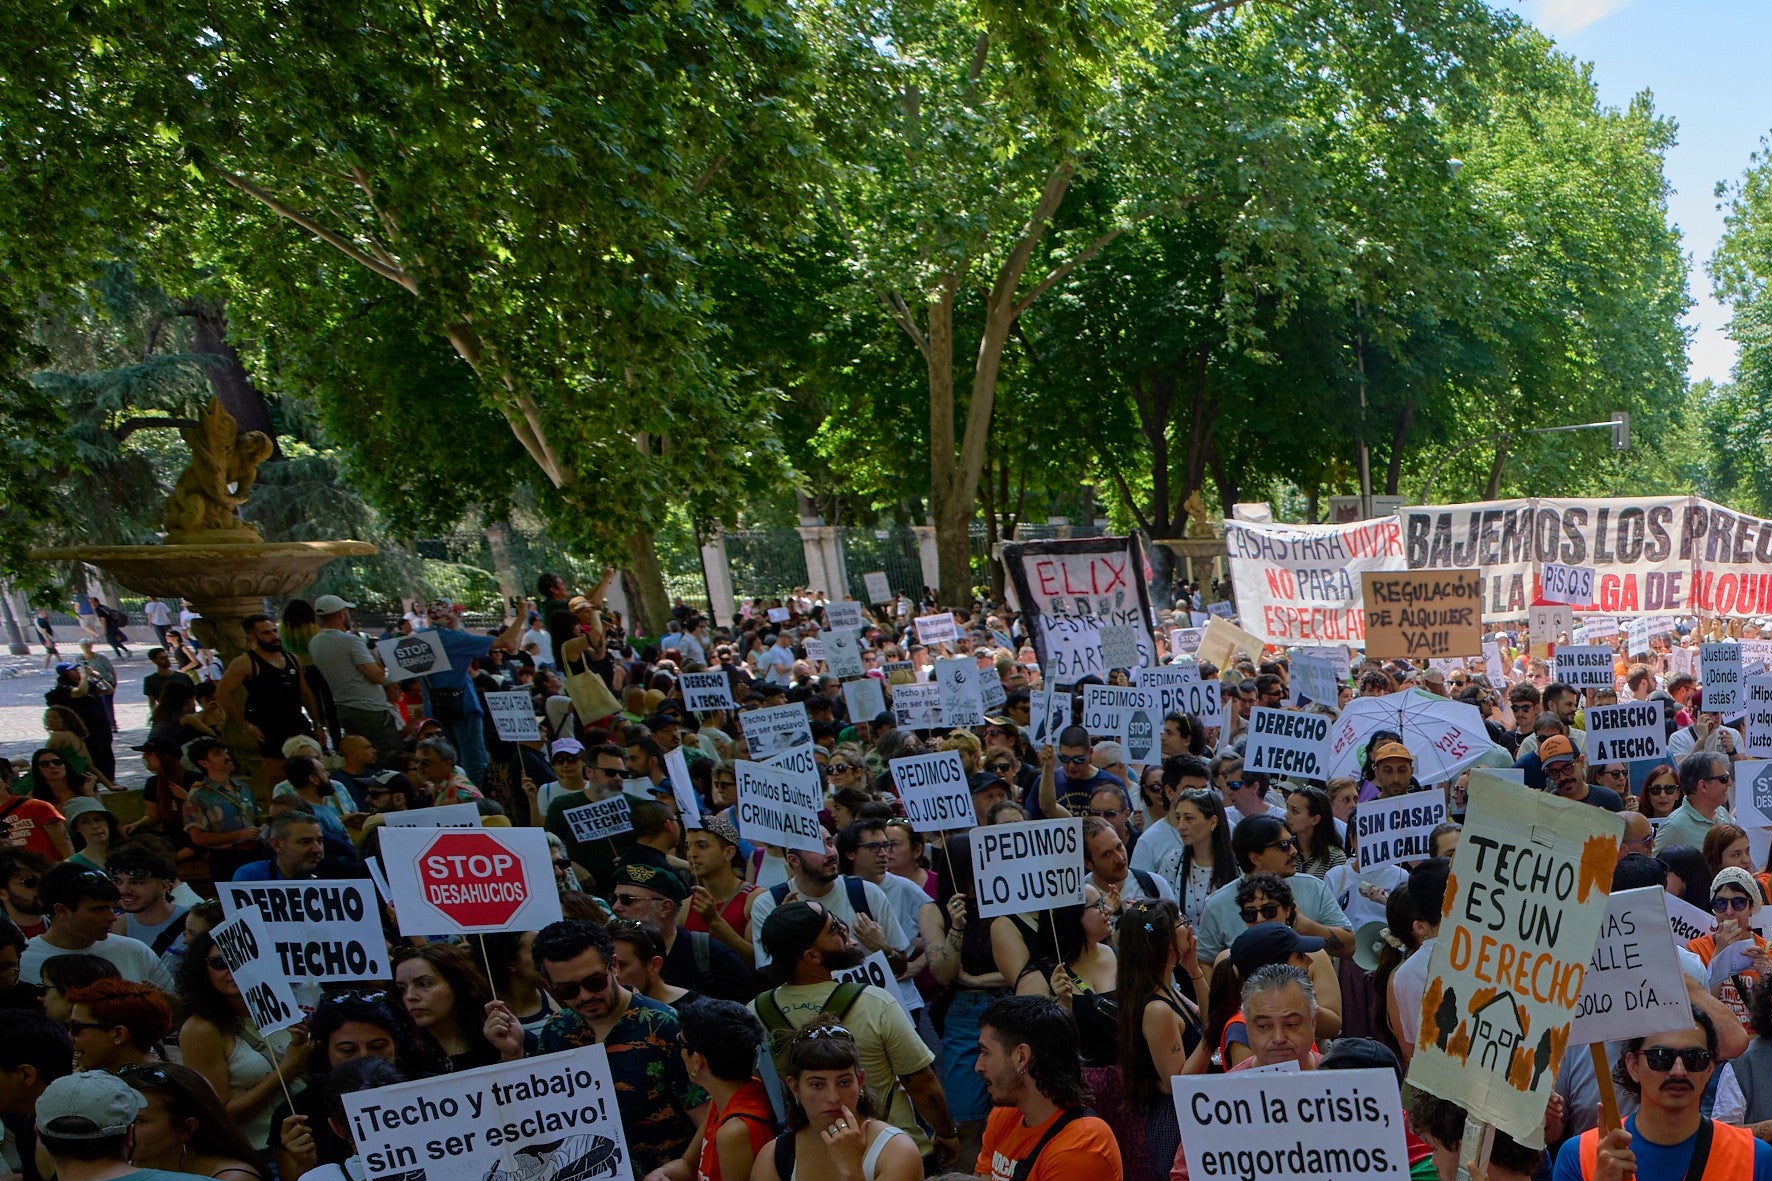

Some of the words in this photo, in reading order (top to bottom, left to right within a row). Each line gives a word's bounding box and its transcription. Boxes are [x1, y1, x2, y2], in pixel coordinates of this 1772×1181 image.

[1342, 523, 1403, 559] VIVIR
[1407, 506, 1588, 569] BAJEMOS
[1594, 506, 1673, 564] LOS
[1036, 558, 1126, 596] ELIX
[1265, 568, 1294, 600] NO
[1296, 568, 1354, 600] PARA
[1372, 575, 1480, 606] REGULACIÓN
[1492, 573, 1526, 613] LA
[1645, 570, 1683, 610] DE
[1545, 566, 1592, 598] PiS.O.S.
[1369, 611, 1393, 627] DE
[1398, 607, 1473, 629] ALQUILER
[396, 642, 429, 660] STOP
[1180, 634, 1200, 643] STOP
[1402, 630, 1449, 655] YA!!!
[1556, 654, 1574, 667] SIN
[1577, 653, 1612, 666] CASA?
[1701, 647, 1740, 664] ¡Justicia!
[684, 675, 724, 688] DERECHO
[1557, 672, 1565, 685] A
[1566, 672, 1580, 685] LA
[1582, 671, 1613, 685] CALLE!
[1705, 668, 1738, 687] ¿Dónde
[690, 696, 698, 708] A
[700, 695, 730, 707] TECHO.
[1708, 689, 1737, 705] estás?
[1129, 723, 1151, 734] STOP
[1254, 711, 1327, 742] DERECHO
[1252, 748, 1263, 767] A
[1266, 746, 1321, 775] TECHO.
[738, 773, 780, 801] ¡Fondos
[740, 802, 823, 840] CRIMINALES!
[977, 826, 1077, 871] ¡PEDIMOS
[425, 853, 514, 880] STOP
[1469, 833, 1574, 901] TECHO
[429, 882, 524, 905] DESAHUCIOS
[978, 875, 1010, 906] LO
[1018, 867, 1082, 900] JUSTO!
[1465, 883, 1506, 931] ES
[1517, 899, 1563, 949] UN
[1450, 923, 1585, 1011] DERECHO
[353, 1096, 458, 1142] ¡Techo
[465, 1091, 483, 1120] y
[492, 1066, 601, 1108] trabajo,
[1190, 1090, 1254, 1127] Con
[1259, 1089, 1288, 1123] la
[1296, 1088, 1392, 1128] crisis,
[366, 1144, 417, 1172] sin
[428, 1131, 476, 1160] ser
[486, 1097, 608, 1147] esclavo!
